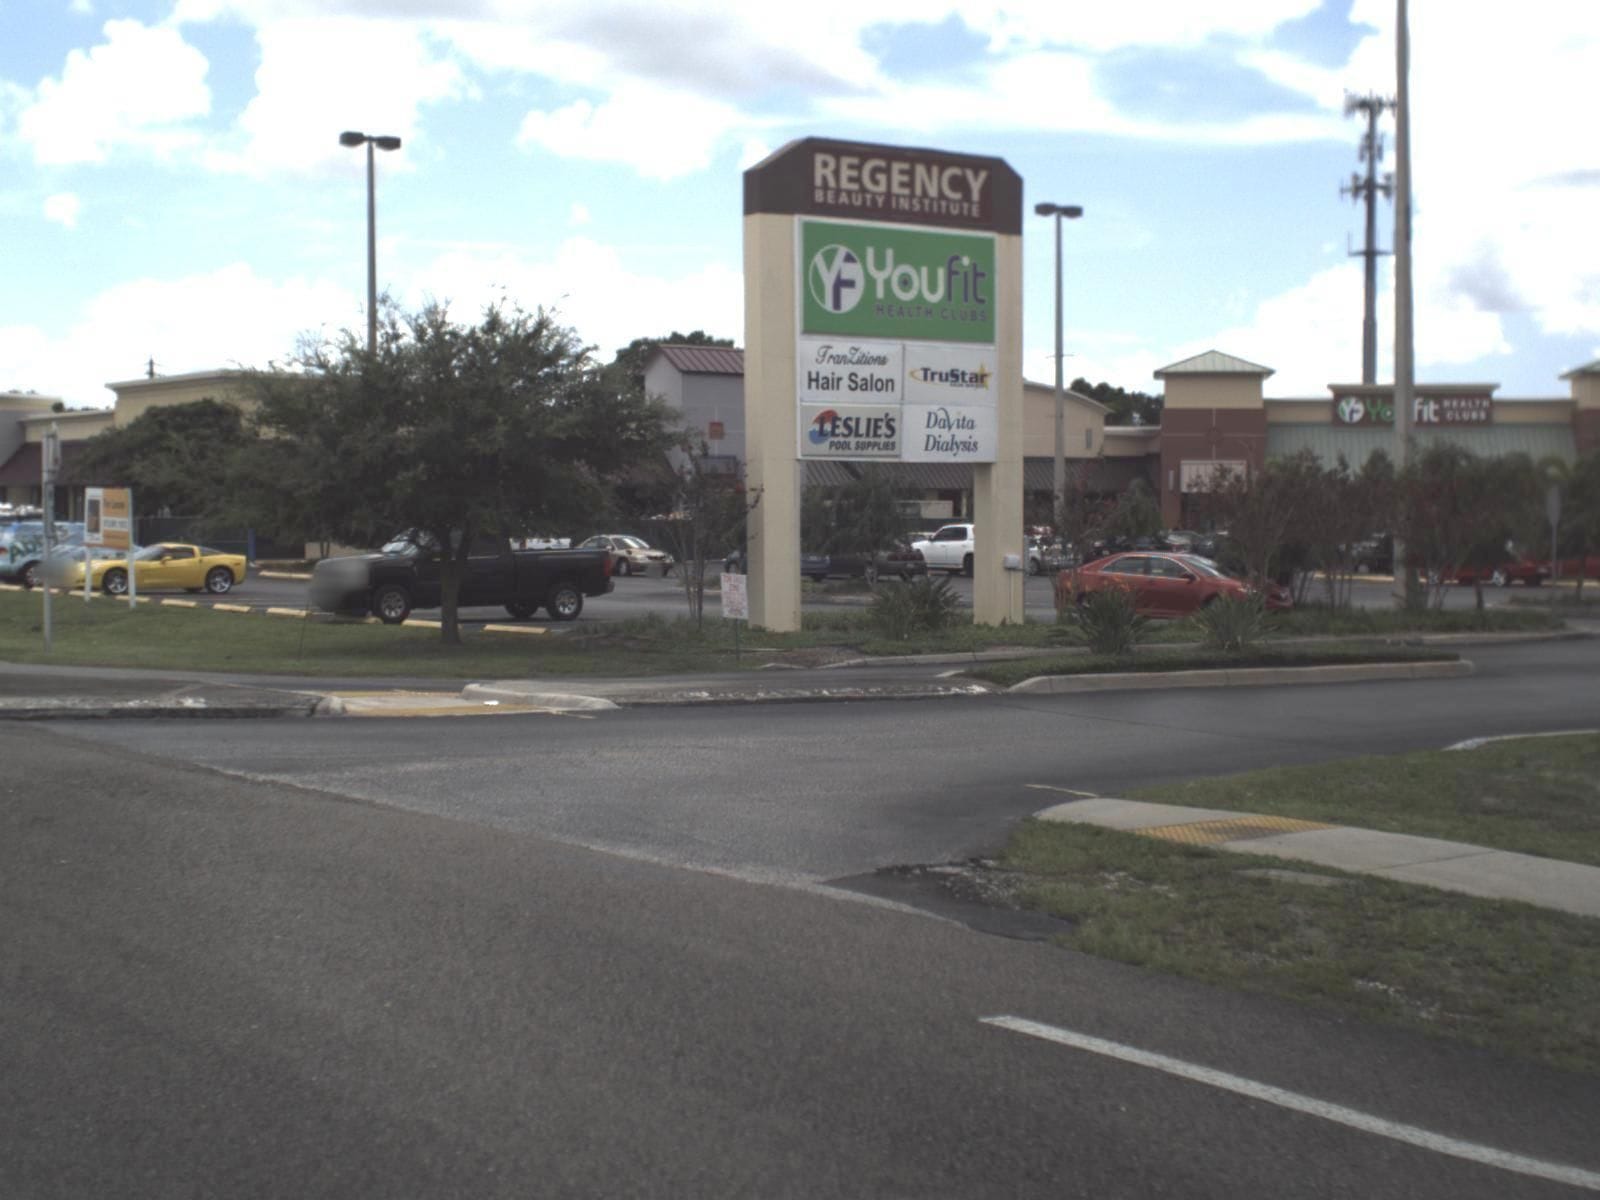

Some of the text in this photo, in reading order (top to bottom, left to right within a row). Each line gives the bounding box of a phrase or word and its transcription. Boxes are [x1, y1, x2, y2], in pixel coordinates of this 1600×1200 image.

[814, 153, 988, 203] REGENCY
[815, 188, 980, 218] BEAUTY INSTITUTE
[874, 304, 987, 322] HEALTH CLUBS
[807, 371, 895, 393] Hair Salon
[920, 367, 987, 384] TruStar
[1442, 399, 1490, 408] HEALTH
[817, 412, 896, 438] LESLIE'S
[829, 440, 896, 451] POOL SUPPLIES
[924, 434, 978, 457] Dialysis
